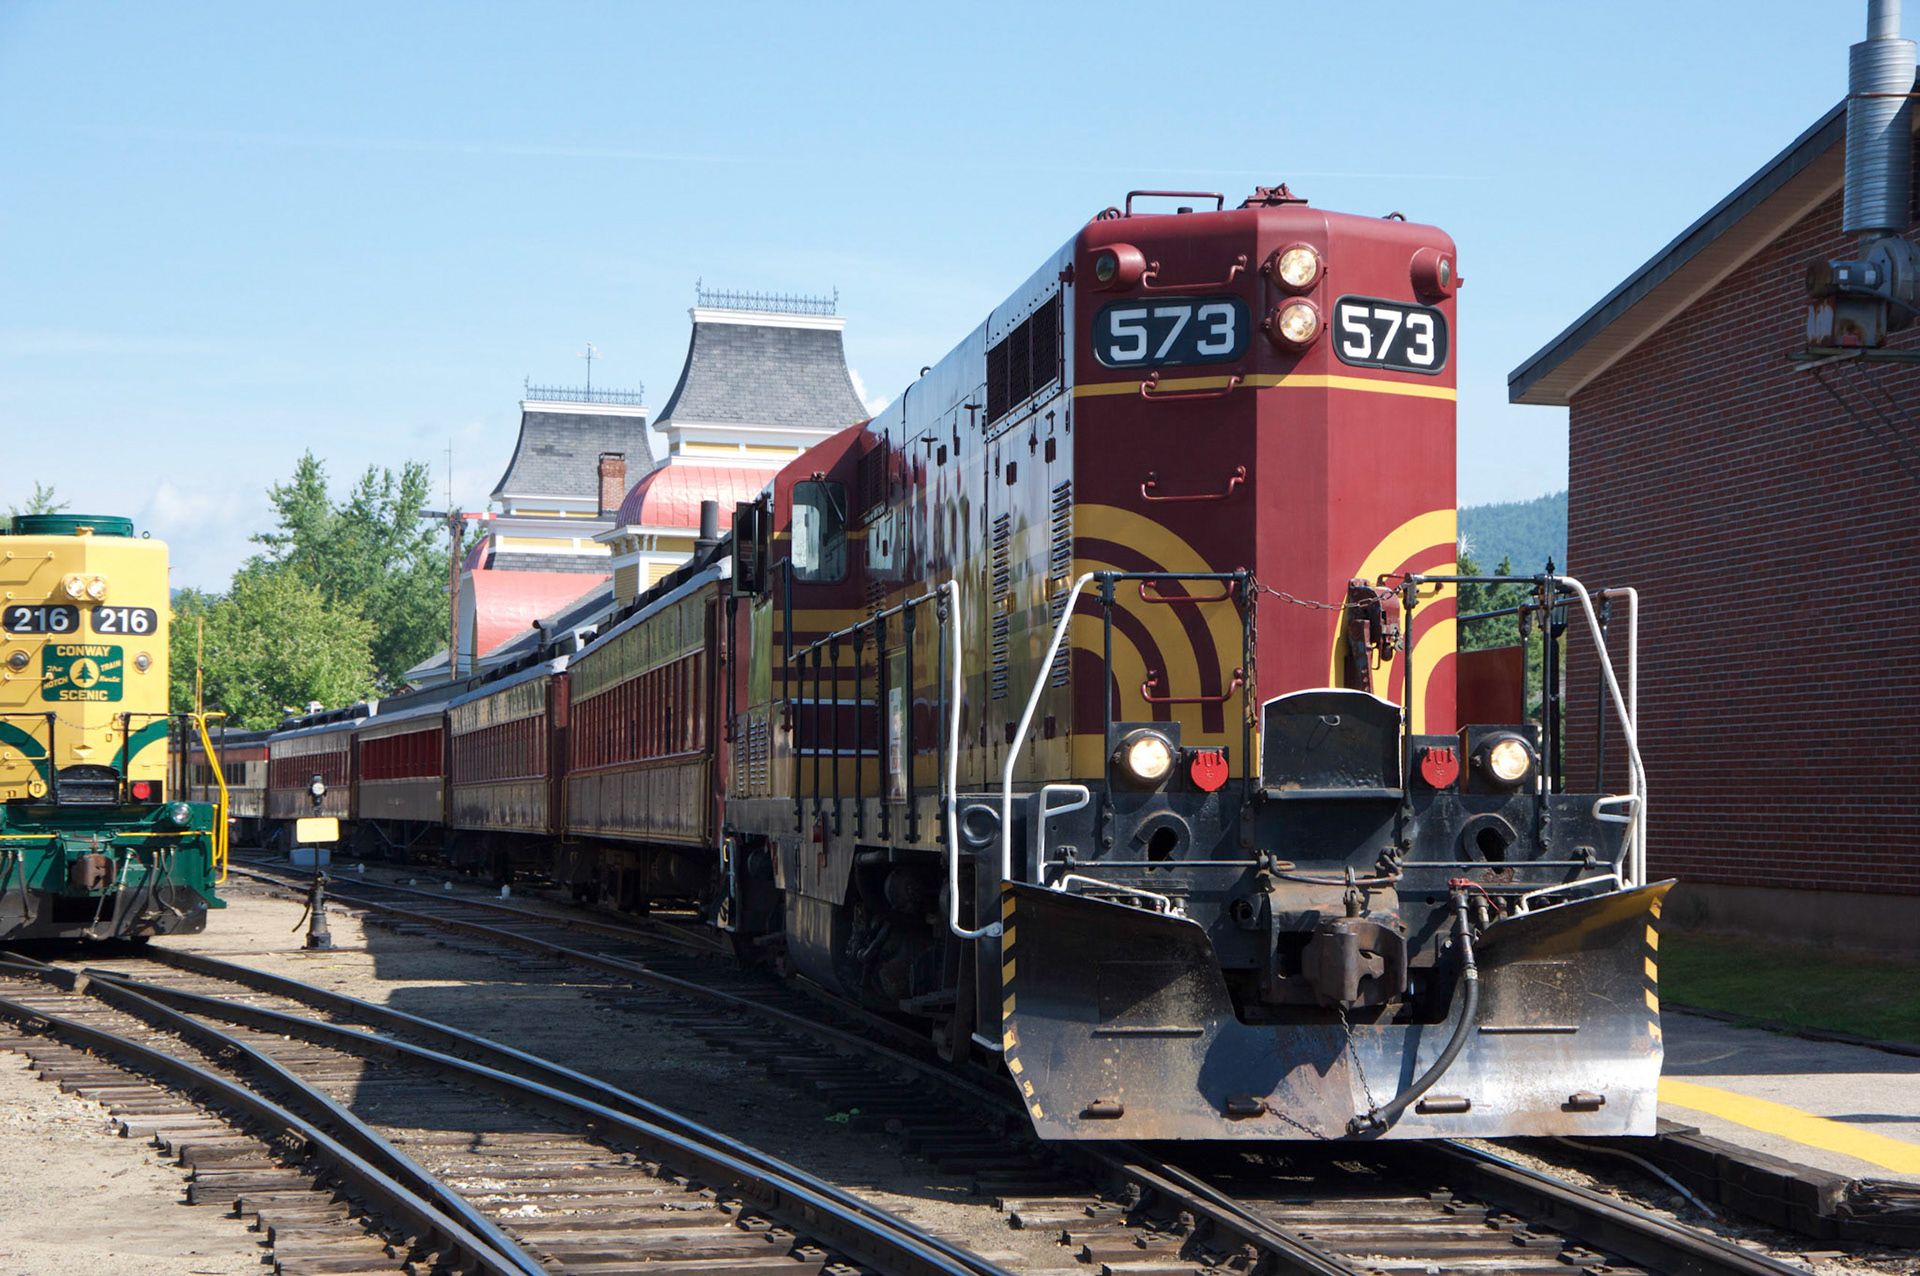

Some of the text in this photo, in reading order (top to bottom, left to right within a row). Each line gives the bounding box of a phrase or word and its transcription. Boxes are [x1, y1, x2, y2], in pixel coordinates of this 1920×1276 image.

[1110, 303, 1236, 361] 573
[1341, 304, 1435, 366] 573
[13, 607, 69, 631] 216
[100, 608, 149, 633] 216
[56, 645, 112, 657] CONWAY
[59, 689, 109, 701] SCENIC
